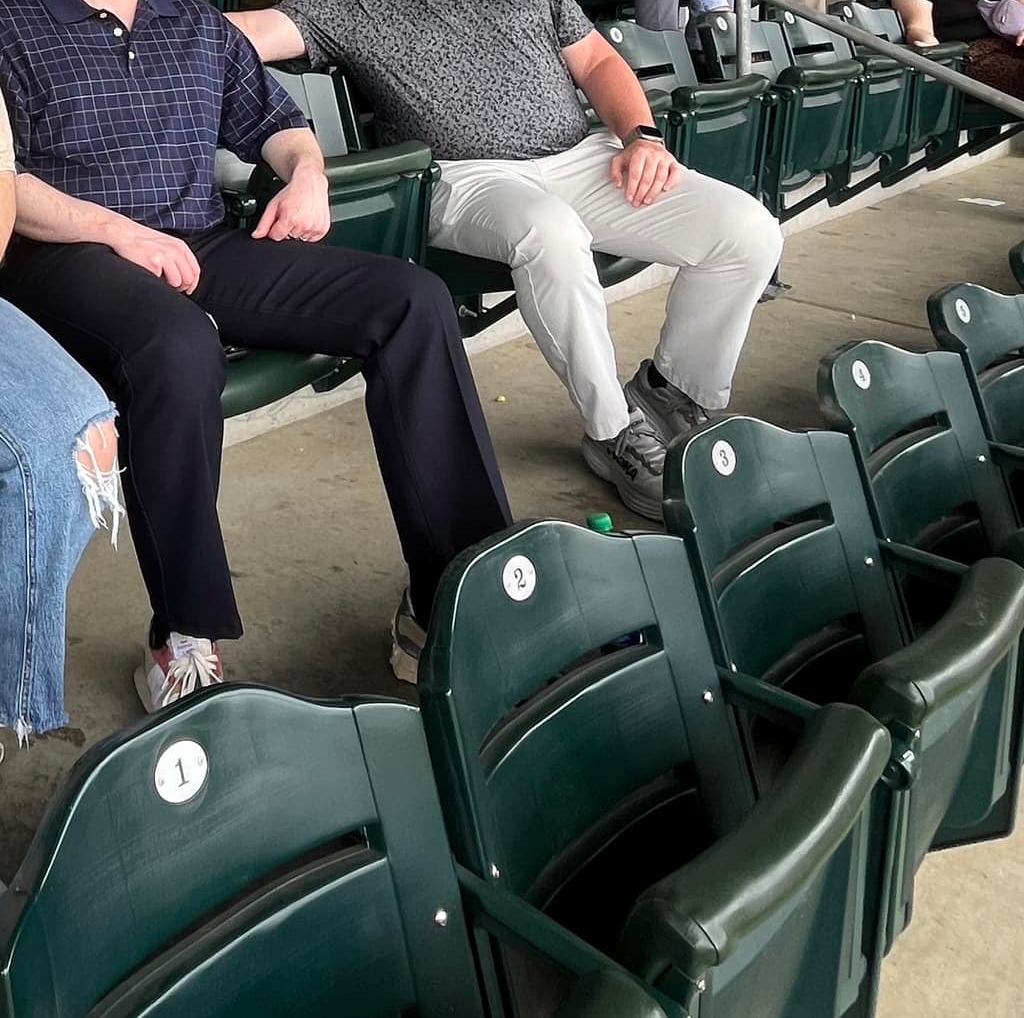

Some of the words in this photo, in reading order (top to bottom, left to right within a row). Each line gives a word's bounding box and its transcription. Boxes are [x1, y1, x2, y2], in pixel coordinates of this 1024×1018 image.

[719, 449, 730, 468] 3
[513, 567, 527, 591] 2
[174, 757, 190, 788] 1
